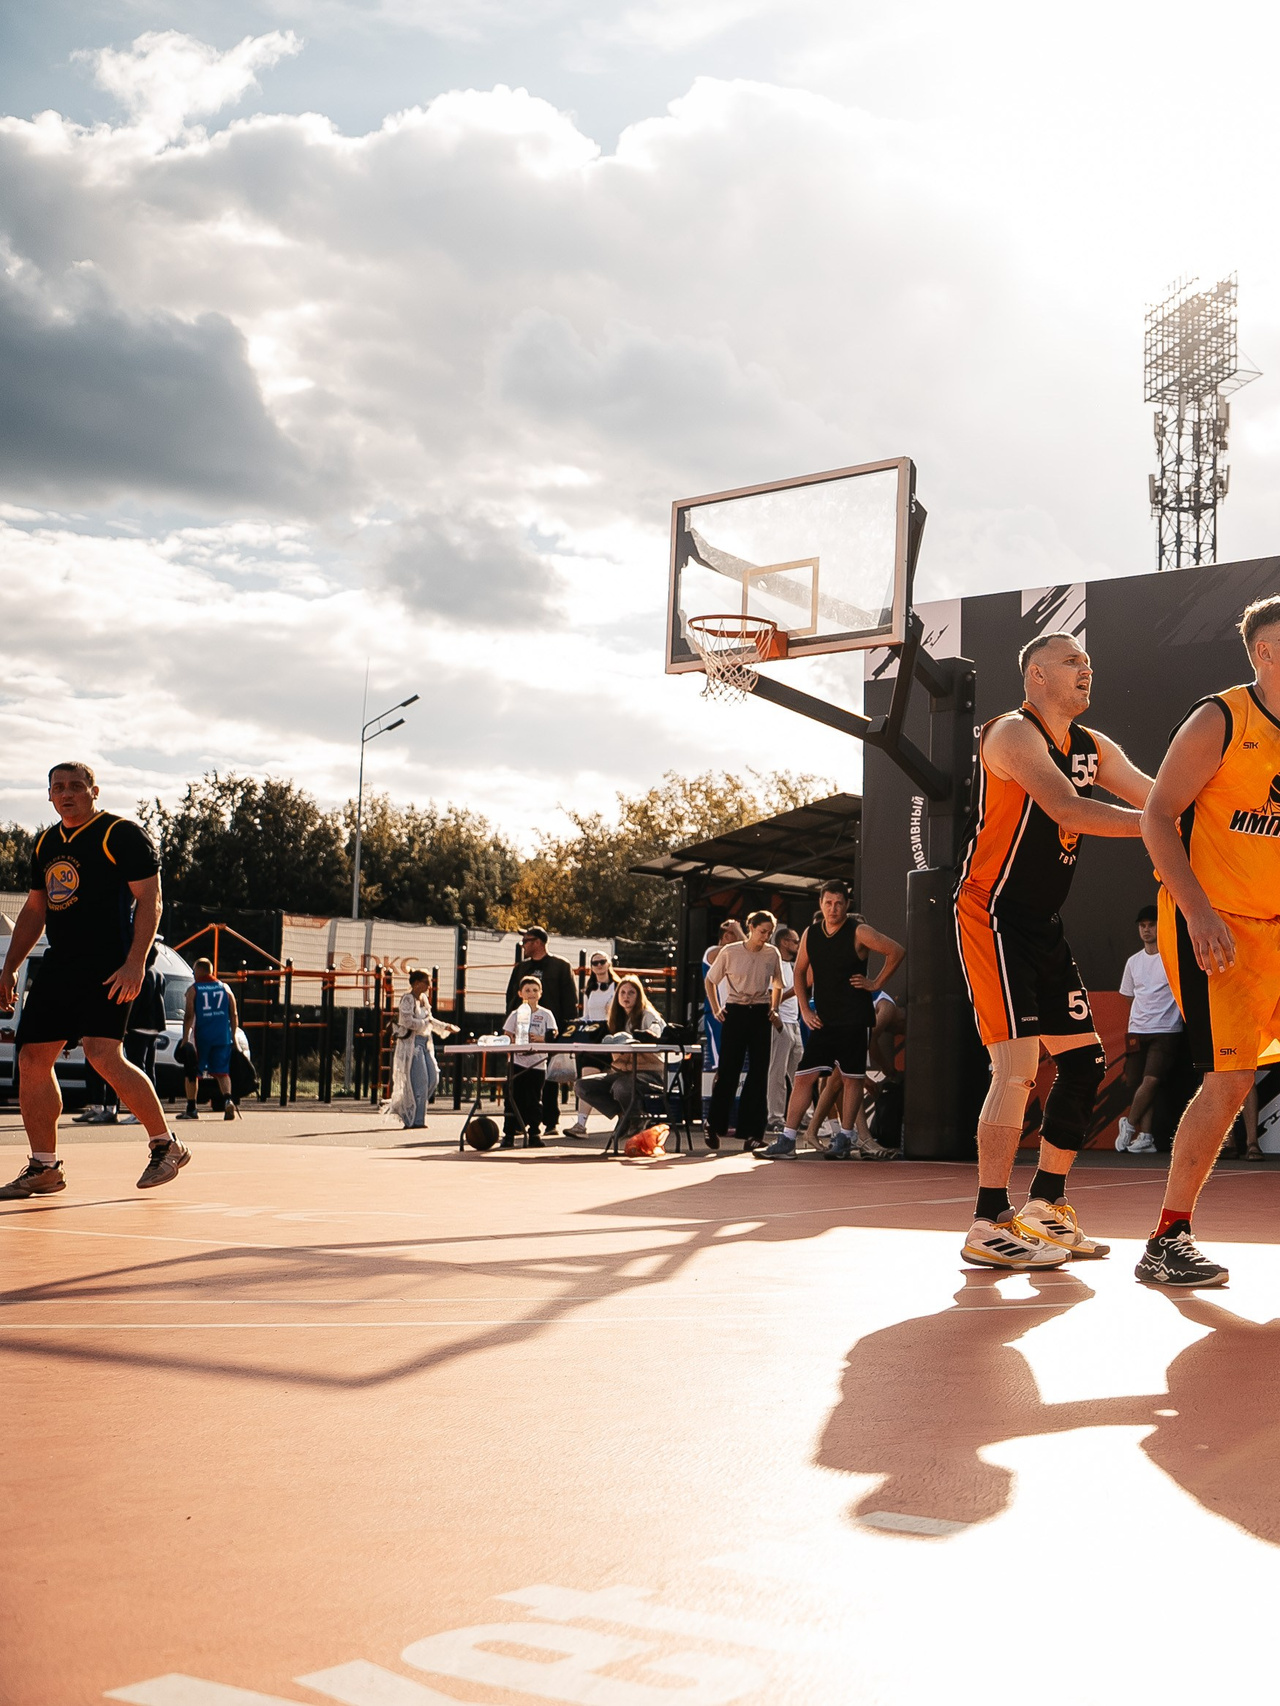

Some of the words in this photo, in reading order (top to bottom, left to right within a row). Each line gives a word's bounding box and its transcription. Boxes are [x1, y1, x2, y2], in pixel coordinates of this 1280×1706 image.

[1071, 753, 1099, 787] 55
[60, 870, 73, 882] 30
[202, 990, 224, 1010] 17
